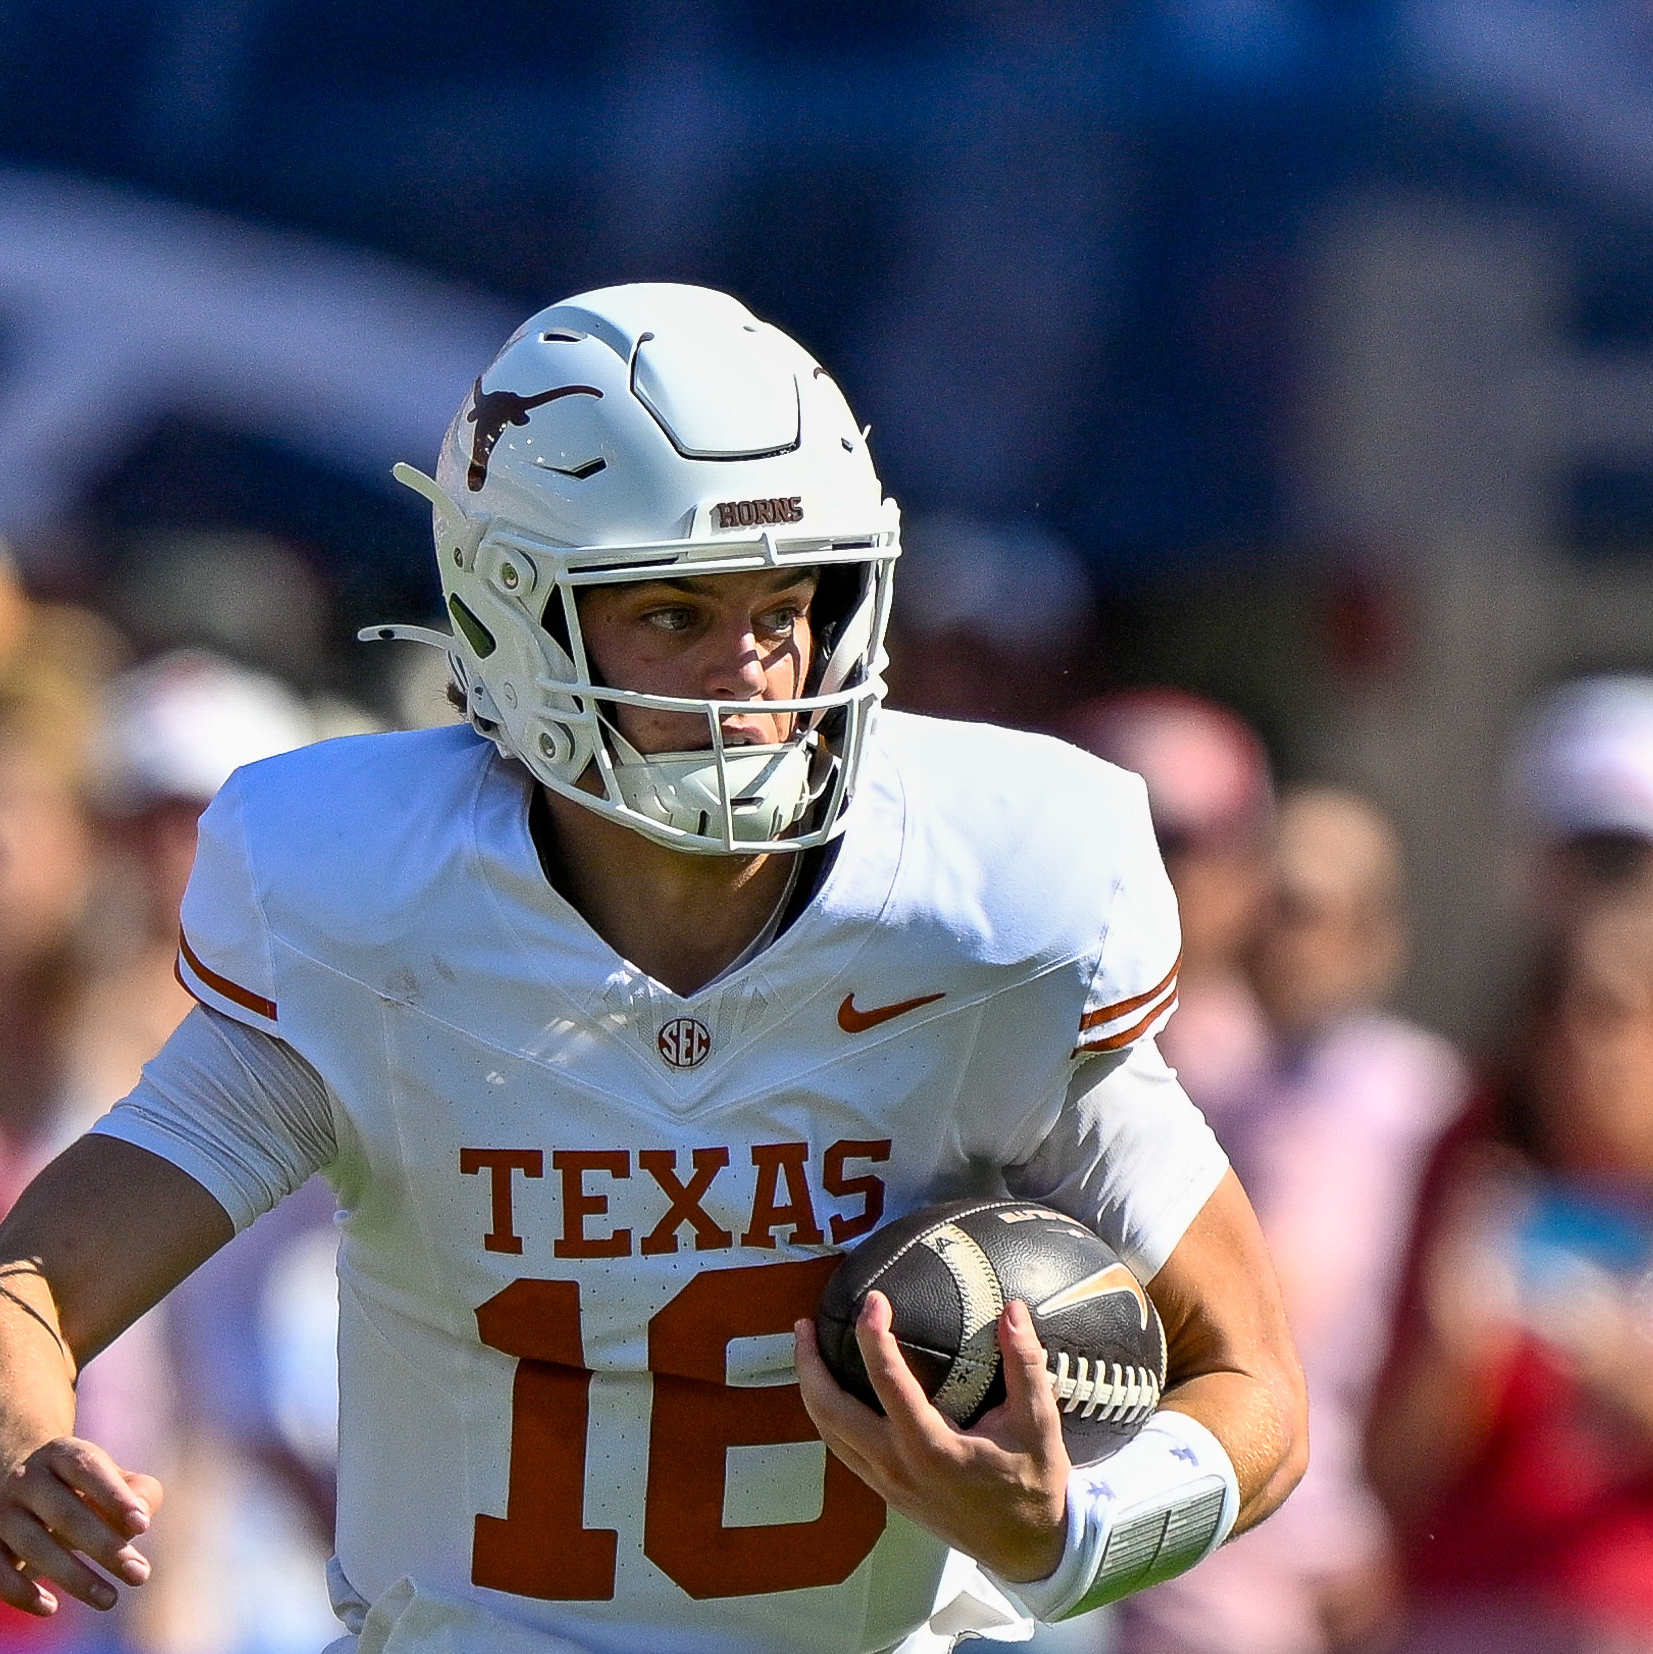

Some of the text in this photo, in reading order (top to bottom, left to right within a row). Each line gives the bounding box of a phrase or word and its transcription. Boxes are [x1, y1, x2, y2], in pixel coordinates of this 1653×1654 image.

[717, 496, 804, 529] HORNS
[662, 1020, 708, 1066] SEC
[459, 1138, 893, 1259] TEXAS
[471, 1254, 887, 1601] 16
